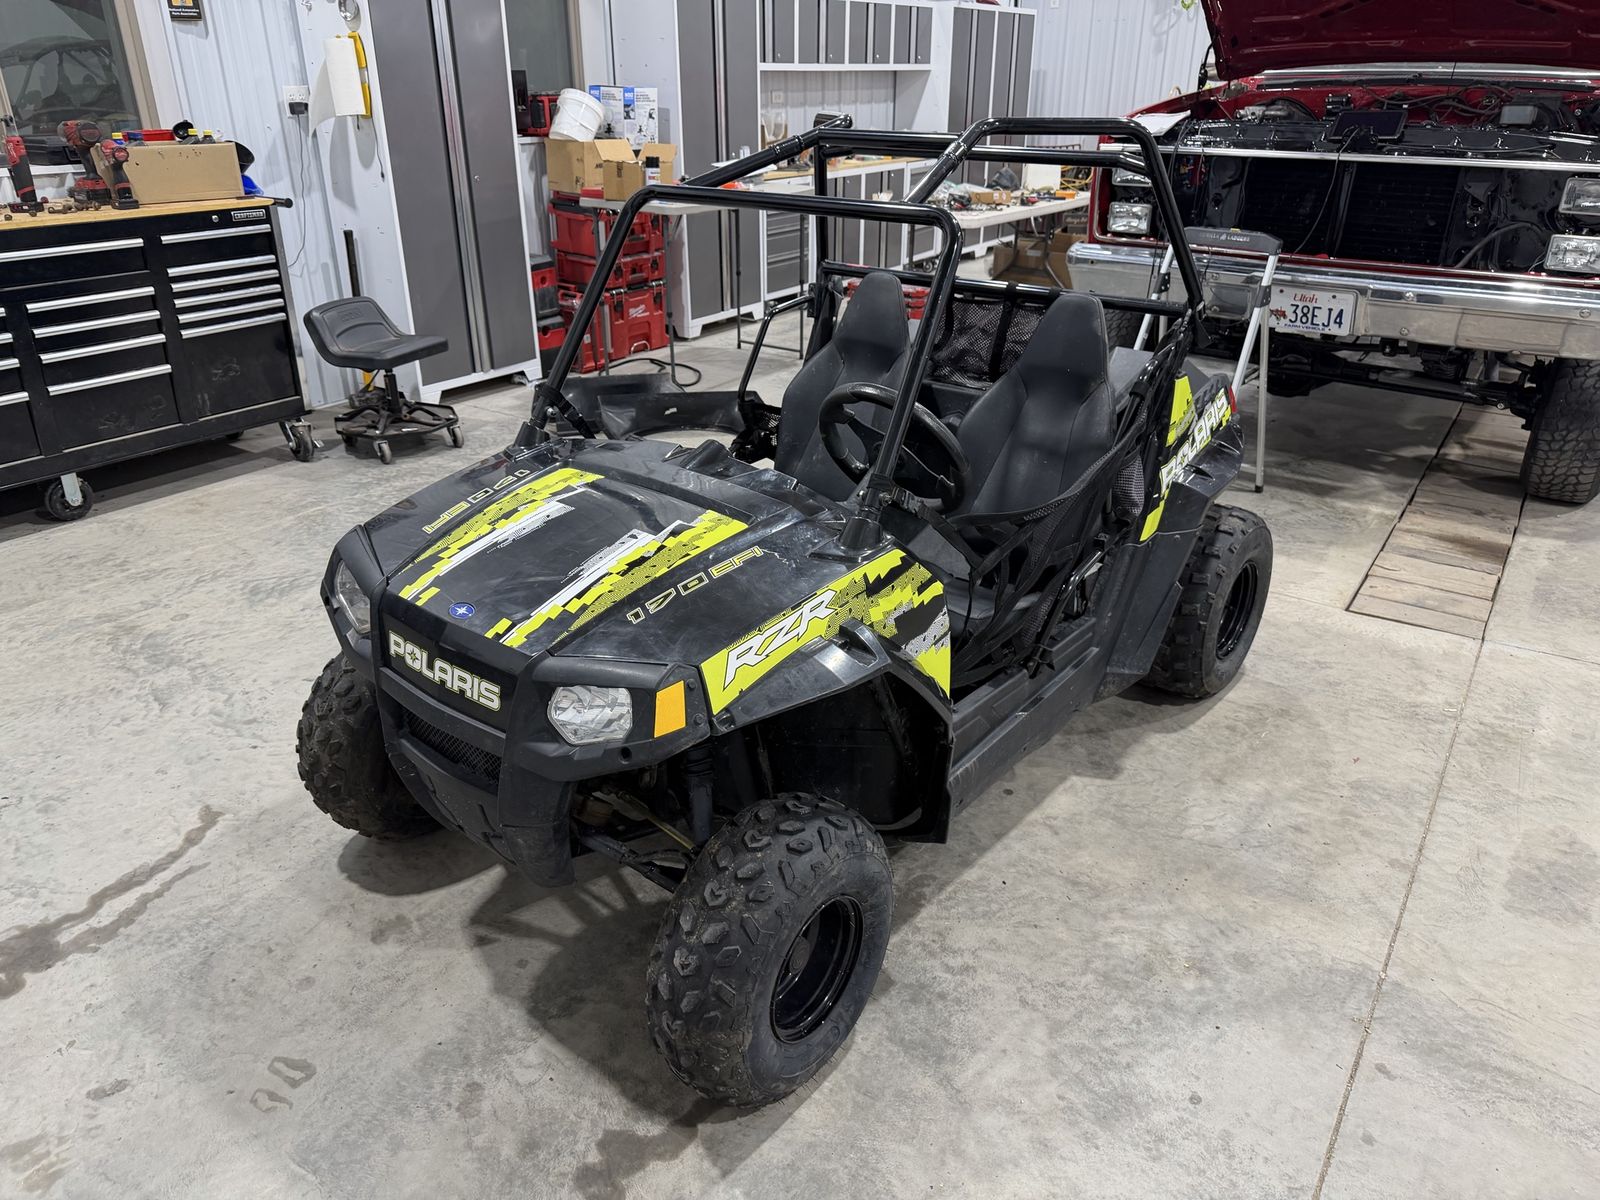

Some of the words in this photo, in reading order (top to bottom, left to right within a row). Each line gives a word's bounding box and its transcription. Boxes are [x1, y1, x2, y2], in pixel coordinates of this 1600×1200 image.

[1288, 303, 1344, 329] 38EJ4
[1293, 293, 1318, 304] Utah
[1159, 387, 1229, 498] POLARIS
[626, 571, 709, 625] 170
[708, 545, 764, 579] EFI
[388, 630, 501, 712] POLARIS
[722, 588, 838, 692] RZR
